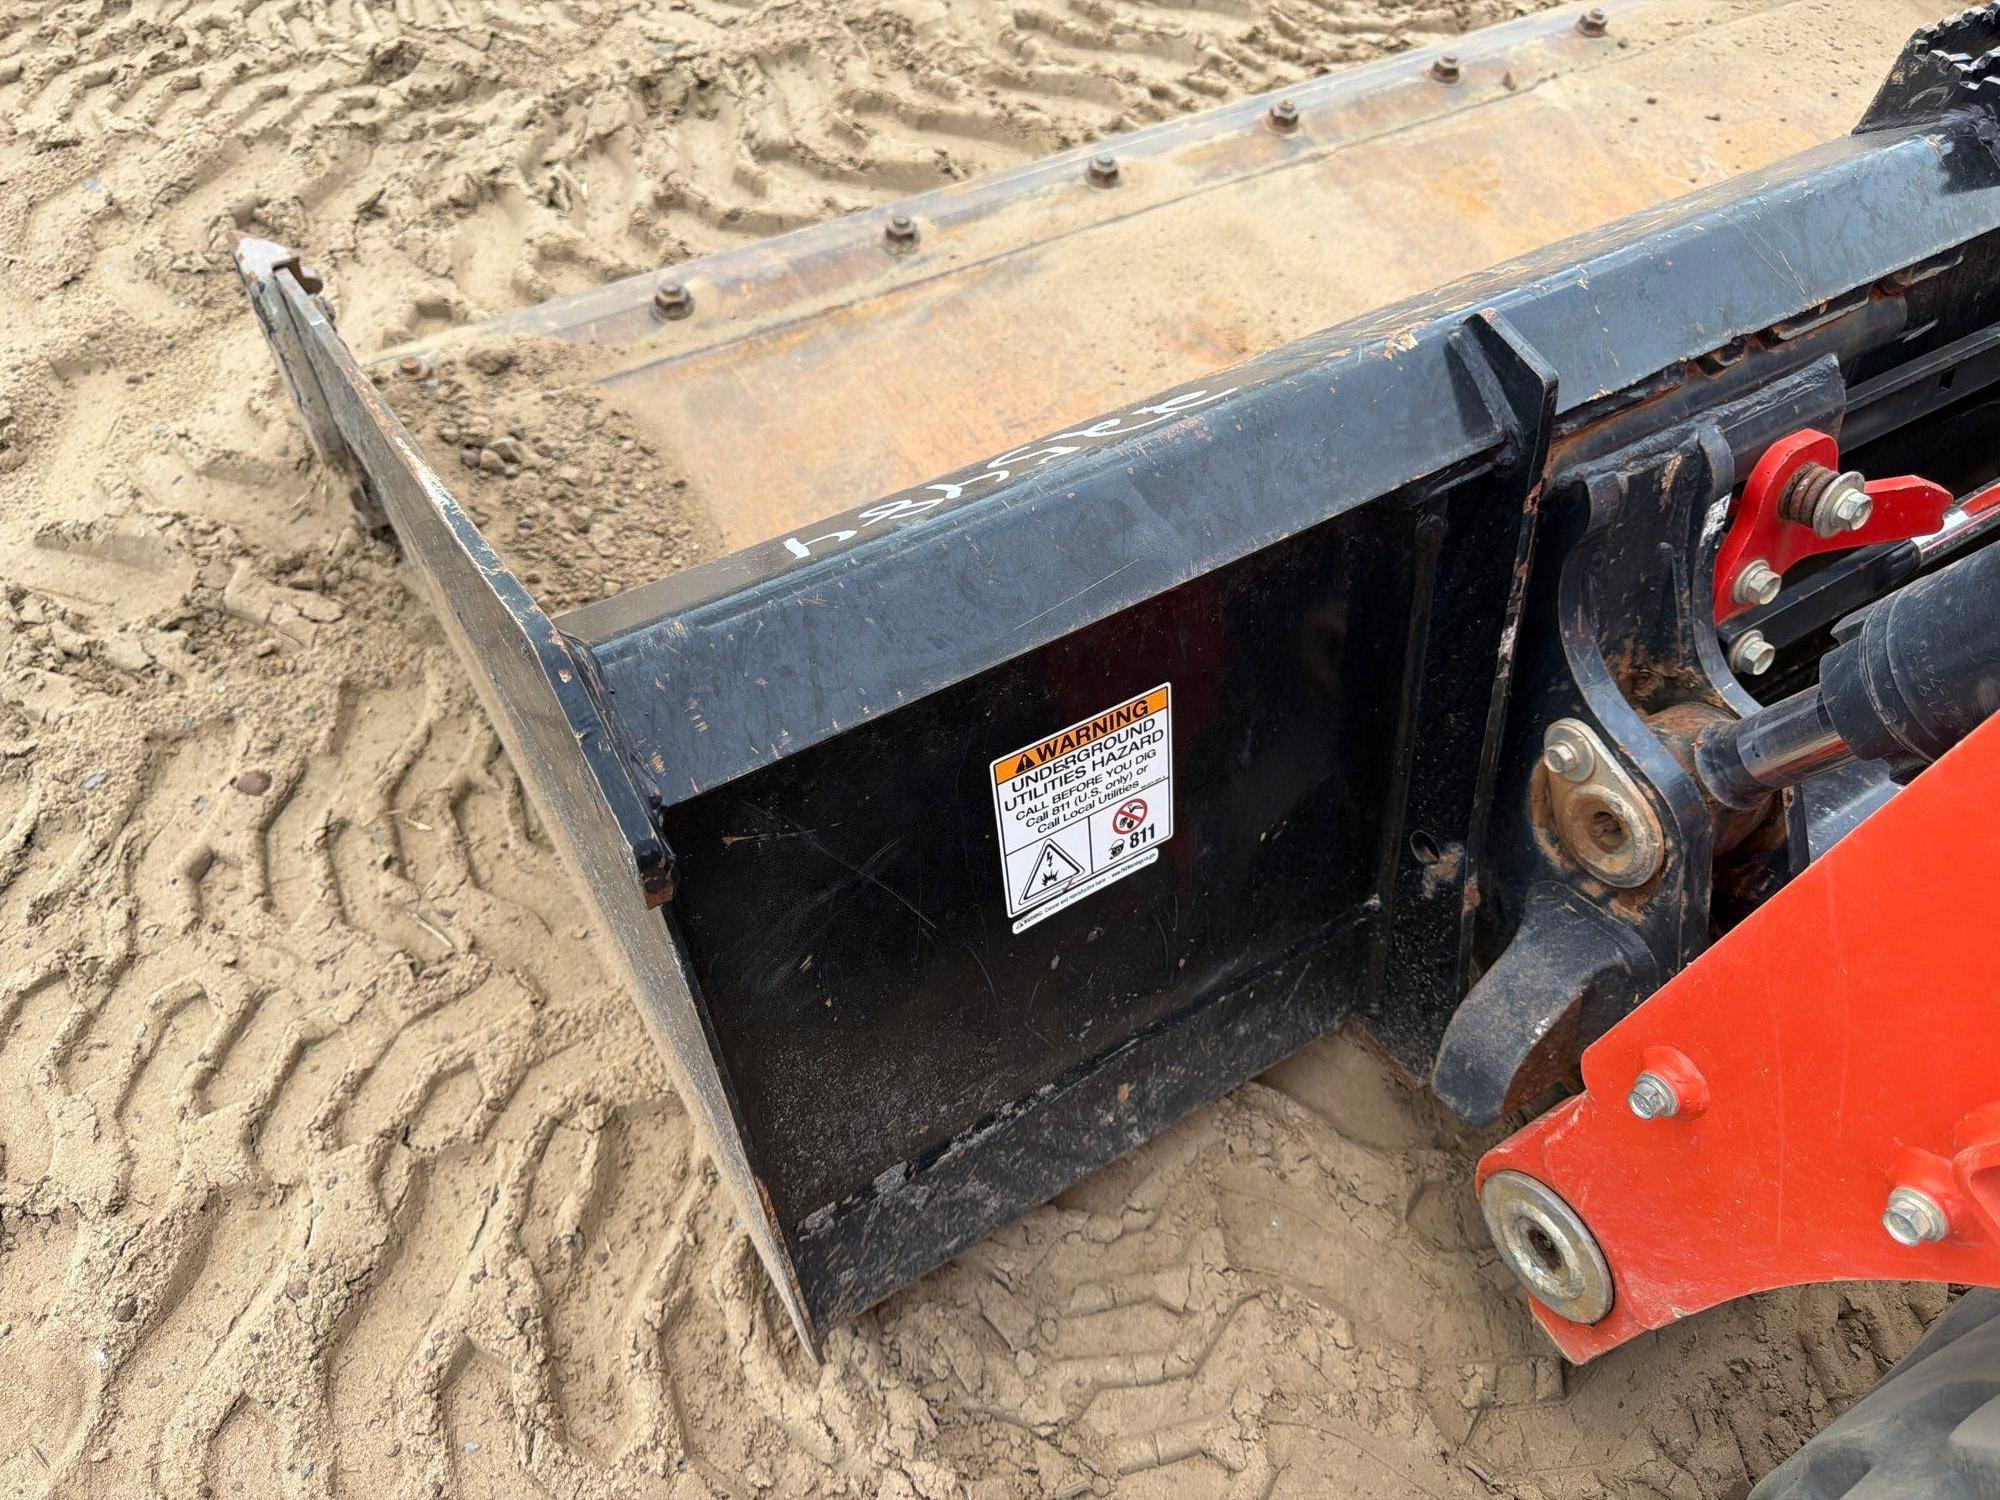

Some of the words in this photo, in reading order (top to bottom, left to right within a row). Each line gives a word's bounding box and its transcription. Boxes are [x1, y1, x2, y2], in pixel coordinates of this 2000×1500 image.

[1011, 718, 1156, 793] UNDERGROUND
[1035, 700, 1149, 762] WARNING
[1004, 765, 1087, 812] UTILITIES
[1092, 729, 1164, 772] HAZARD
[1015, 802, 1049, 821] CALL
[1052, 776, 1103, 804] BEFORE
[1106, 759, 1132, 778] YOU
[1135, 748, 1157, 765] DIG
[1025, 811, 1049, 828] Call
[1052, 802, 1071, 815] 811
[1074, 788, 1102, 808] (U.S.
[1105, 772, 1133, 794] only)
[1136, 764, 1149, 776] or
[1037, 817, 1060, 834] Call
[1063, 801, 1096, 822] Local
[1099, 781, 1140, 805] Utilities
[1129, 822, 1155, 849] 811
